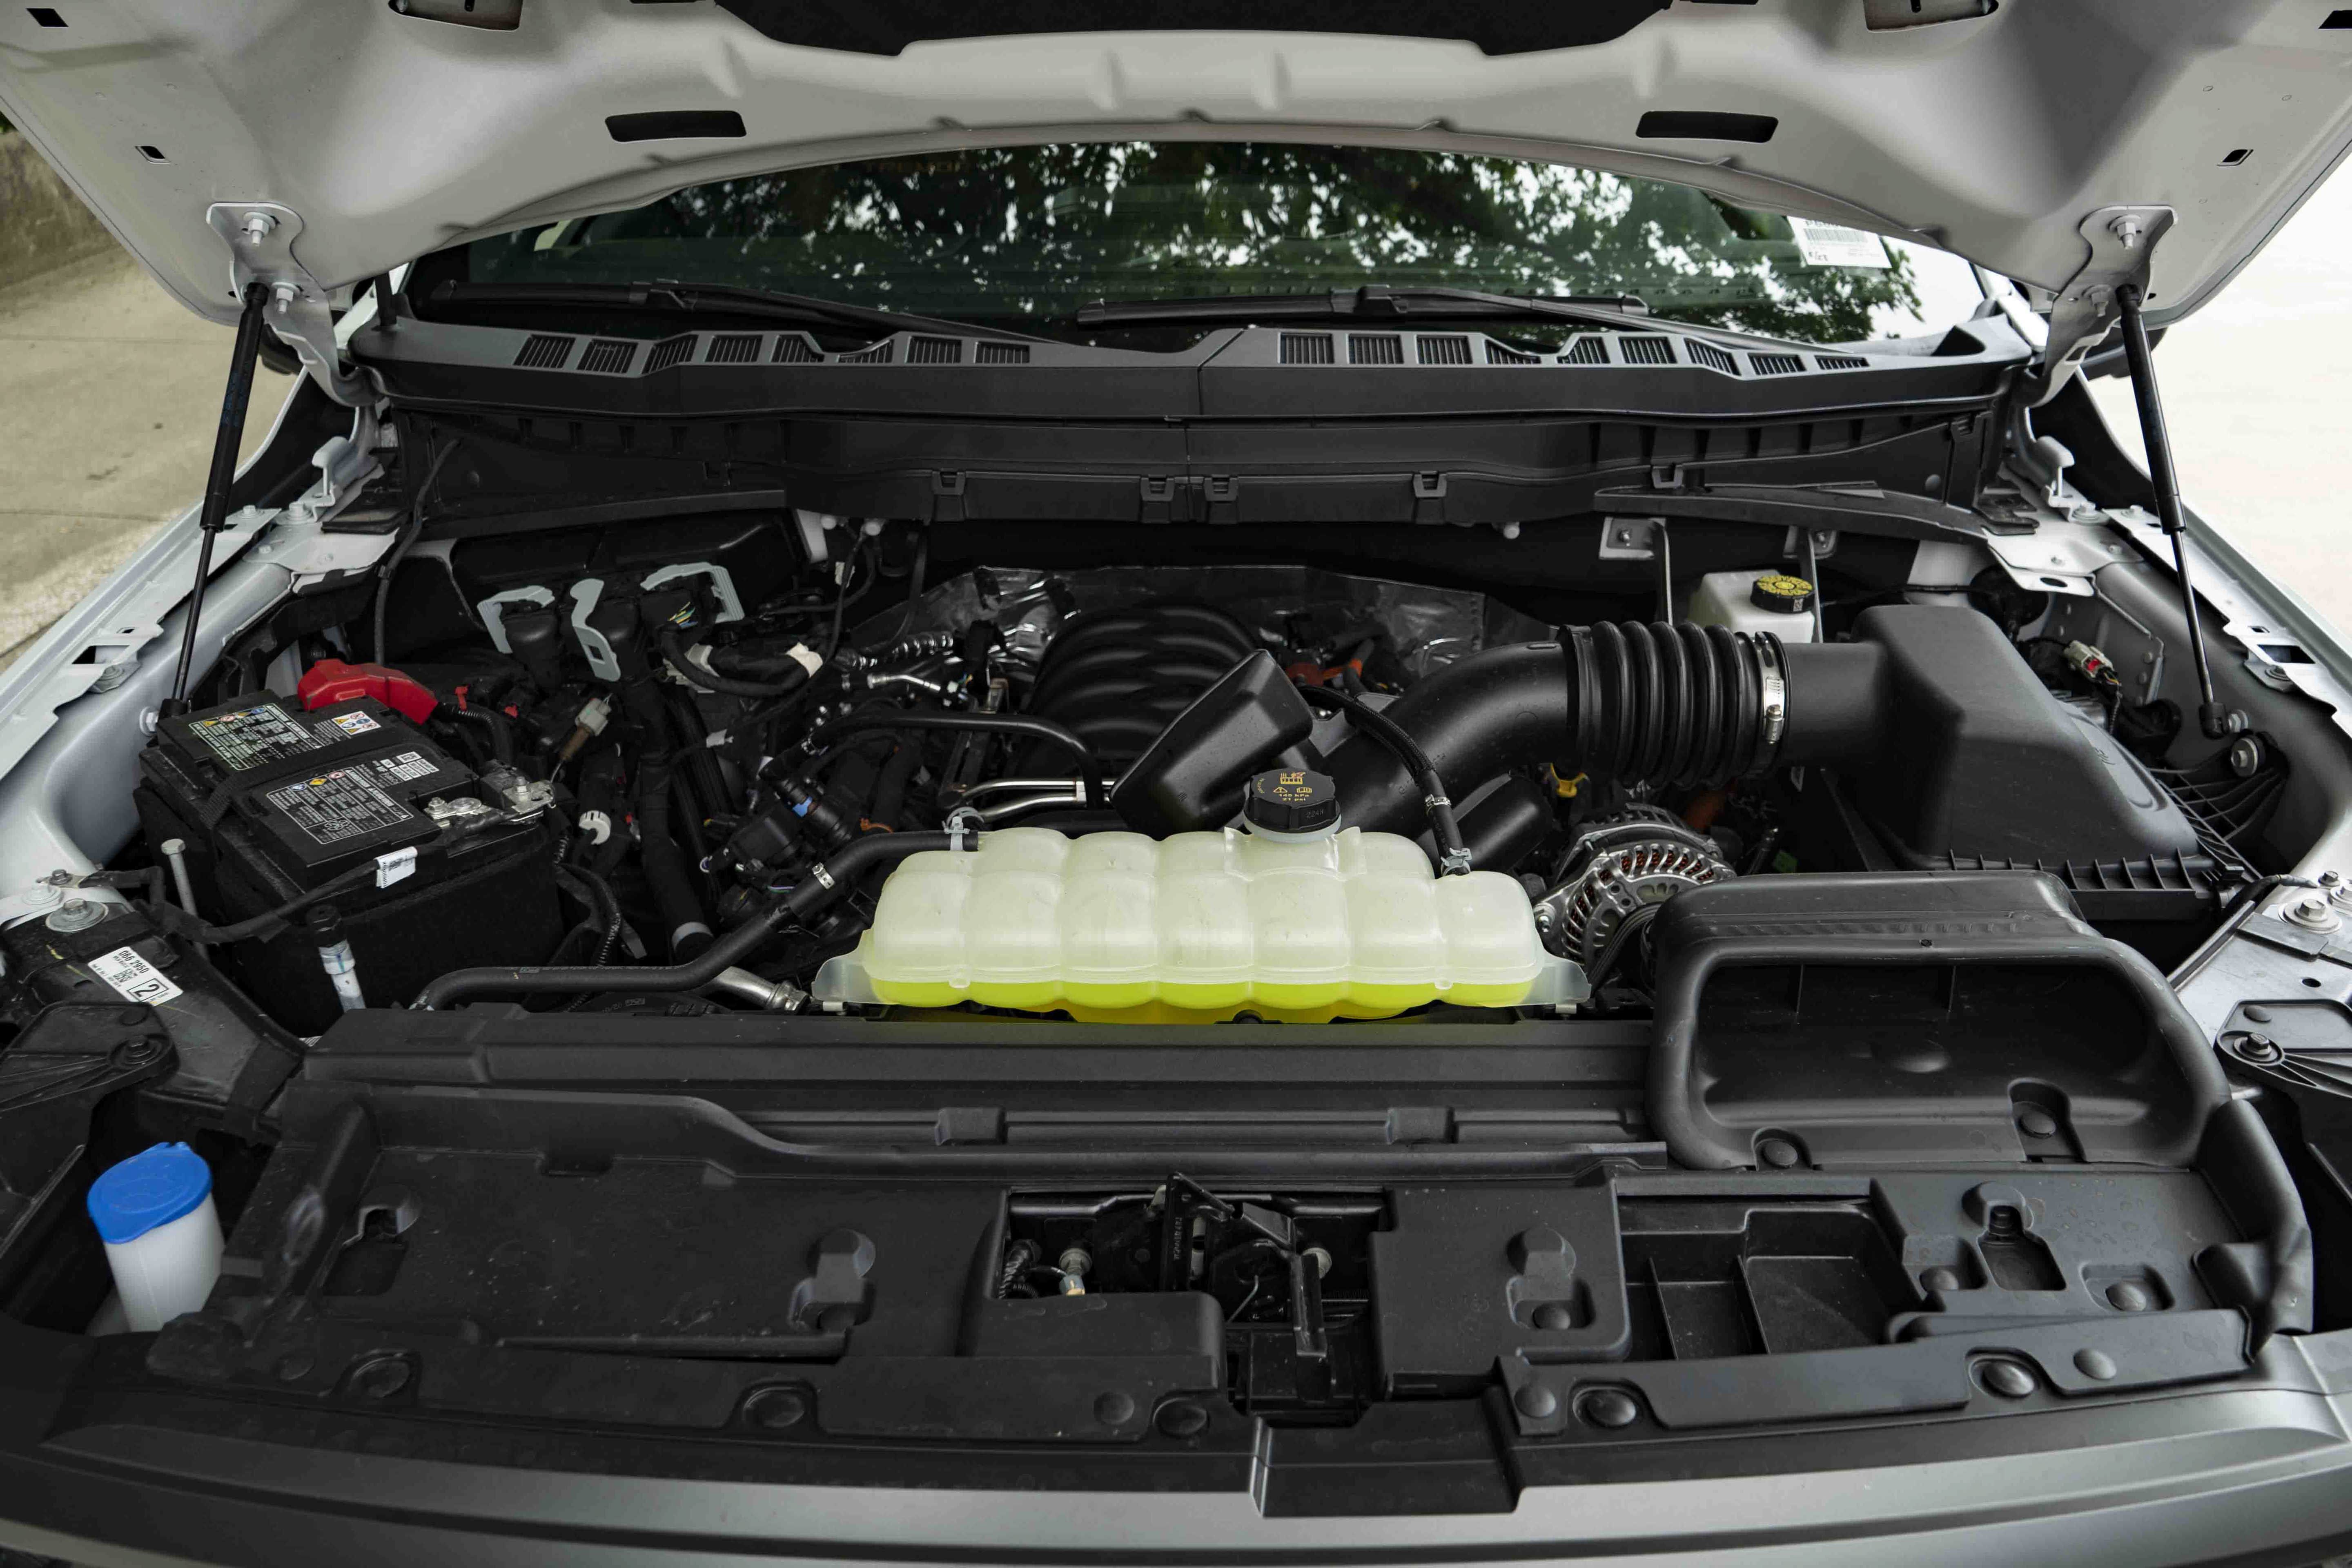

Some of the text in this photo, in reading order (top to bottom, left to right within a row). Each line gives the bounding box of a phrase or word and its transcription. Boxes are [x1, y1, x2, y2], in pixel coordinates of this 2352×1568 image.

[119, 950, 135, 962] 066
[129, 960, 150, 973] 2950
[133, 984, 160, 997] 2
